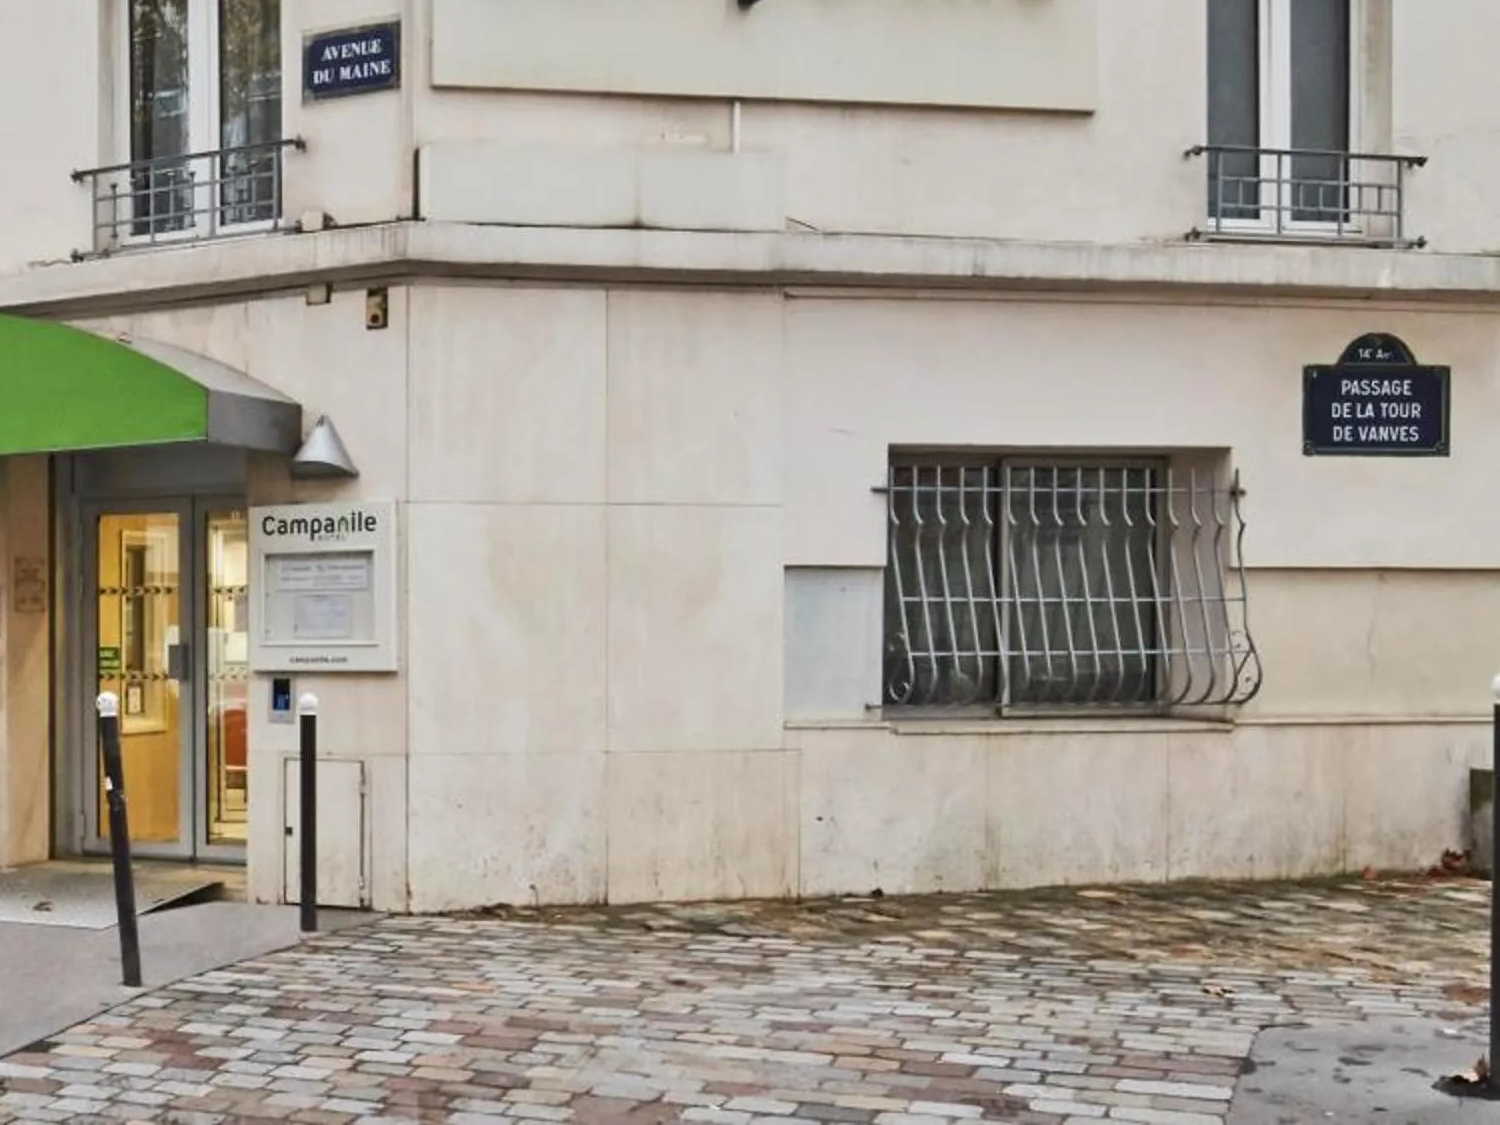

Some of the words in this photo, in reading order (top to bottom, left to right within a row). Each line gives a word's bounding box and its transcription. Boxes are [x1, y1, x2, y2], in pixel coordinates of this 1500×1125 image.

[321, 38, 382, 62] AVENUE
[312, 67, 335, 84] DU
[339, 59, 391, 80] MAINE
[1341, 379, 1413, 396] PASSAGE
[1331, 402, 1352, 418] DE
[1356, 402, 1376, 418] LA
[1379, 402, 1422, 418] TOUR
[1333, 426, 1353, 442] DE
[1357, 426, 1419, 442] VANVES
[261, 510, 377, 541] Campanile
